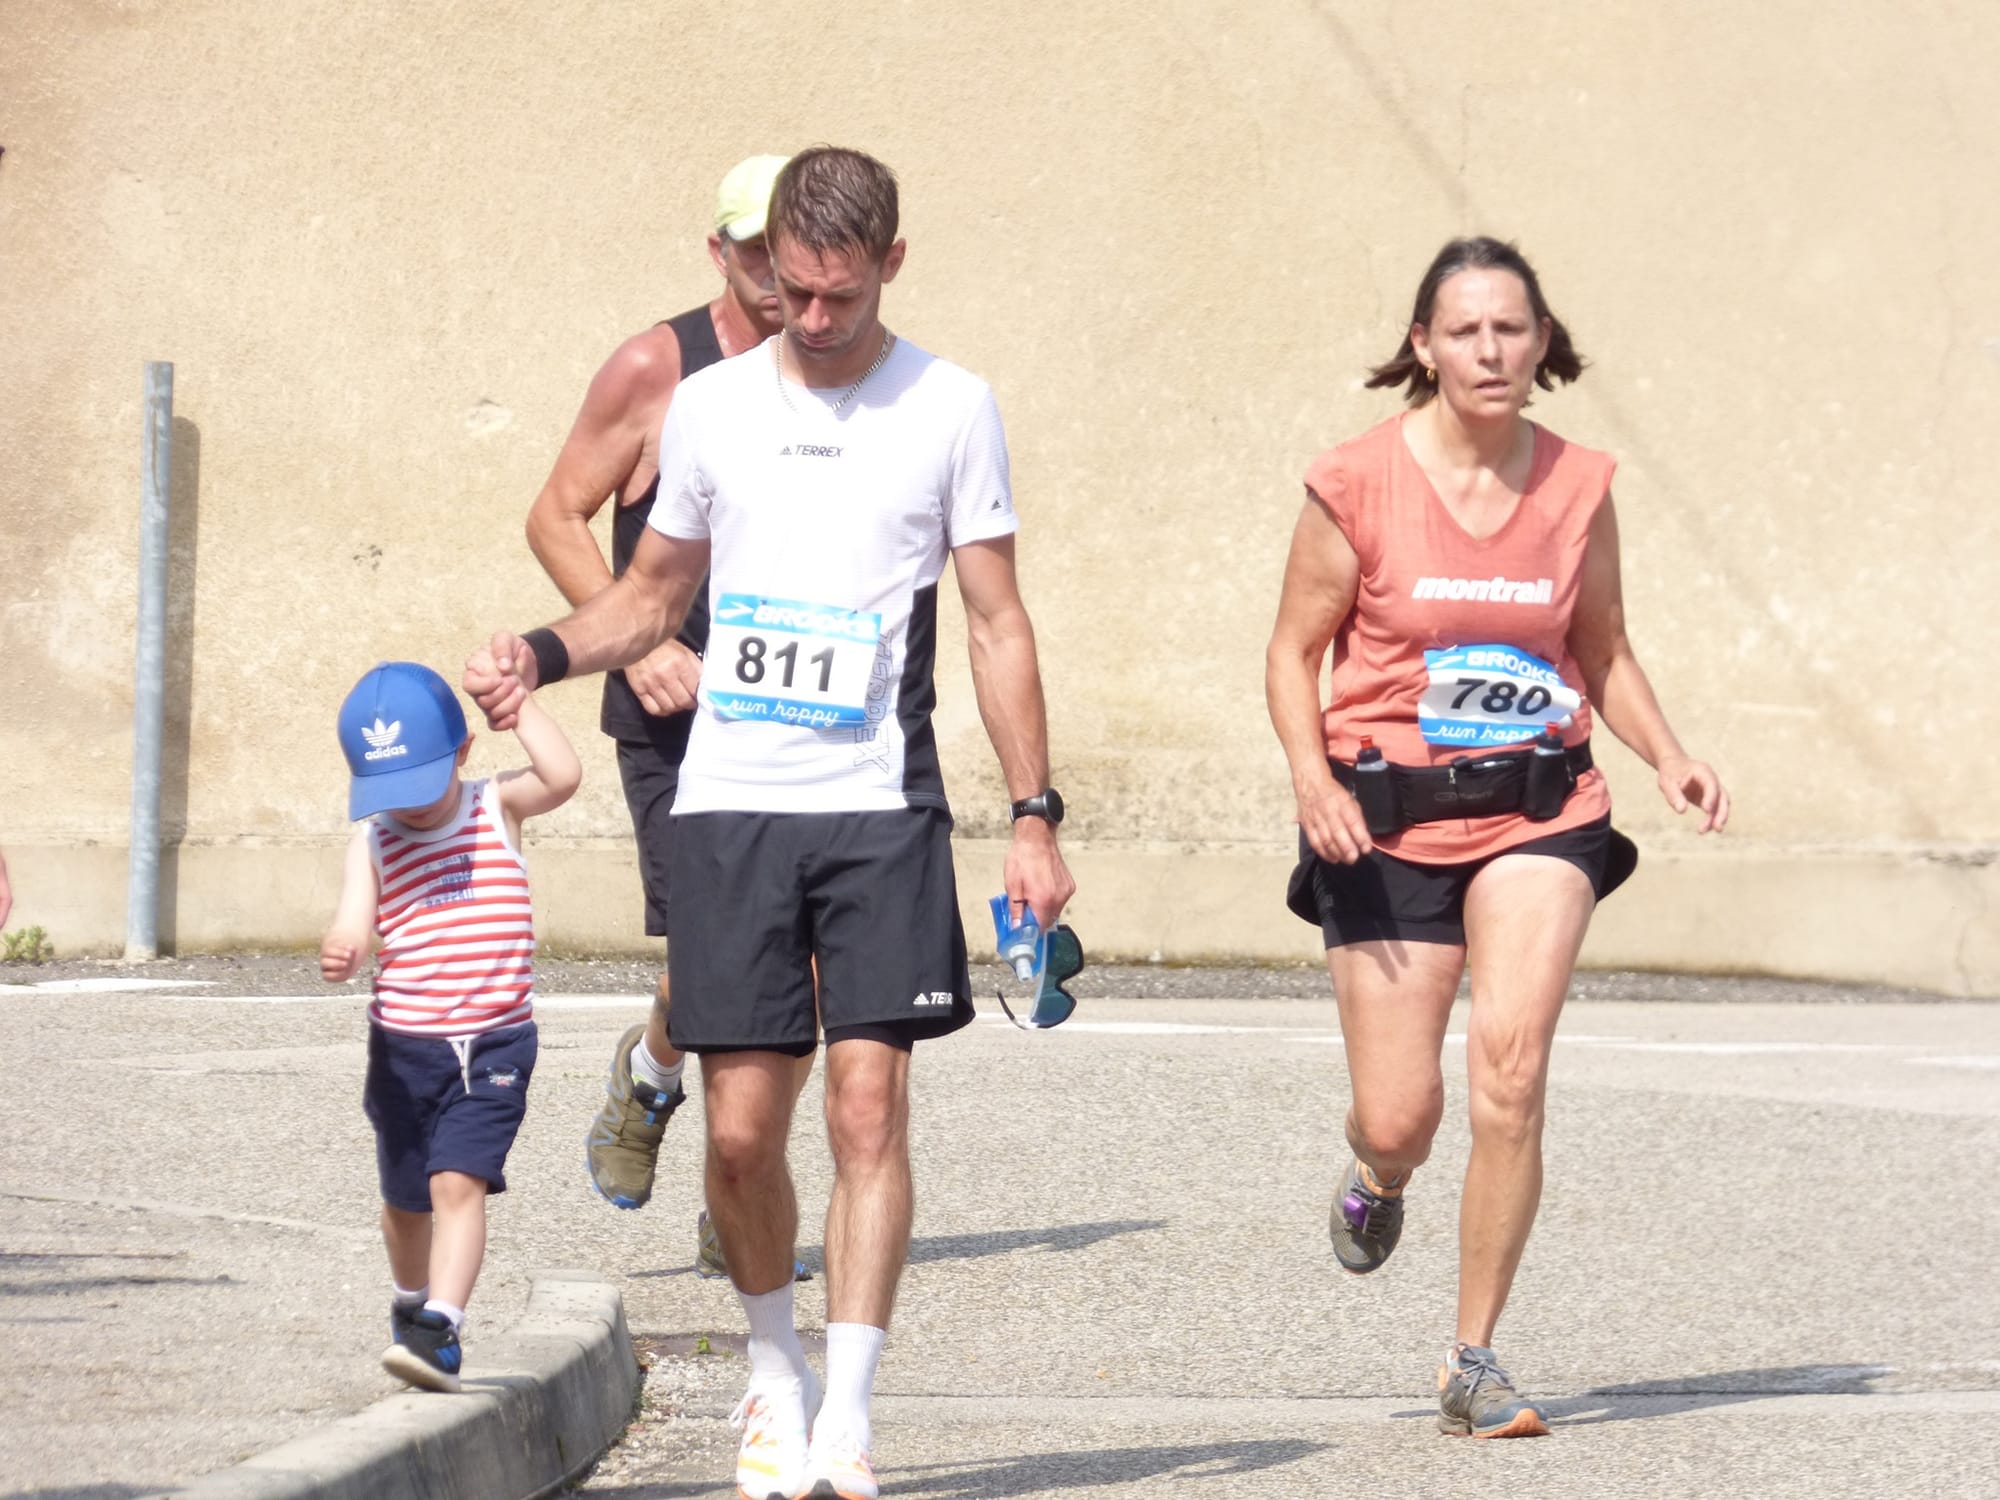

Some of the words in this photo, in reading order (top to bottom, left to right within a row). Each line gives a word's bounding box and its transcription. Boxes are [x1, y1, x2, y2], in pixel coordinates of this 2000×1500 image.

[795, 444, 844, 457] TERREX
[1411, 576, 1553, 605] montrail
[735, 636, 836, 692] 811
[1466, 651, 1560, 686] BROOKS
[1450, 677, 1553, 716] 780
[727, 699, 767, 714] run
[771, 700, 840, 727] happy
[1433, 724, 1476, 738] run
[1479, 724, 1541, 744] happ
[364, 744, 408, 760] adidas
